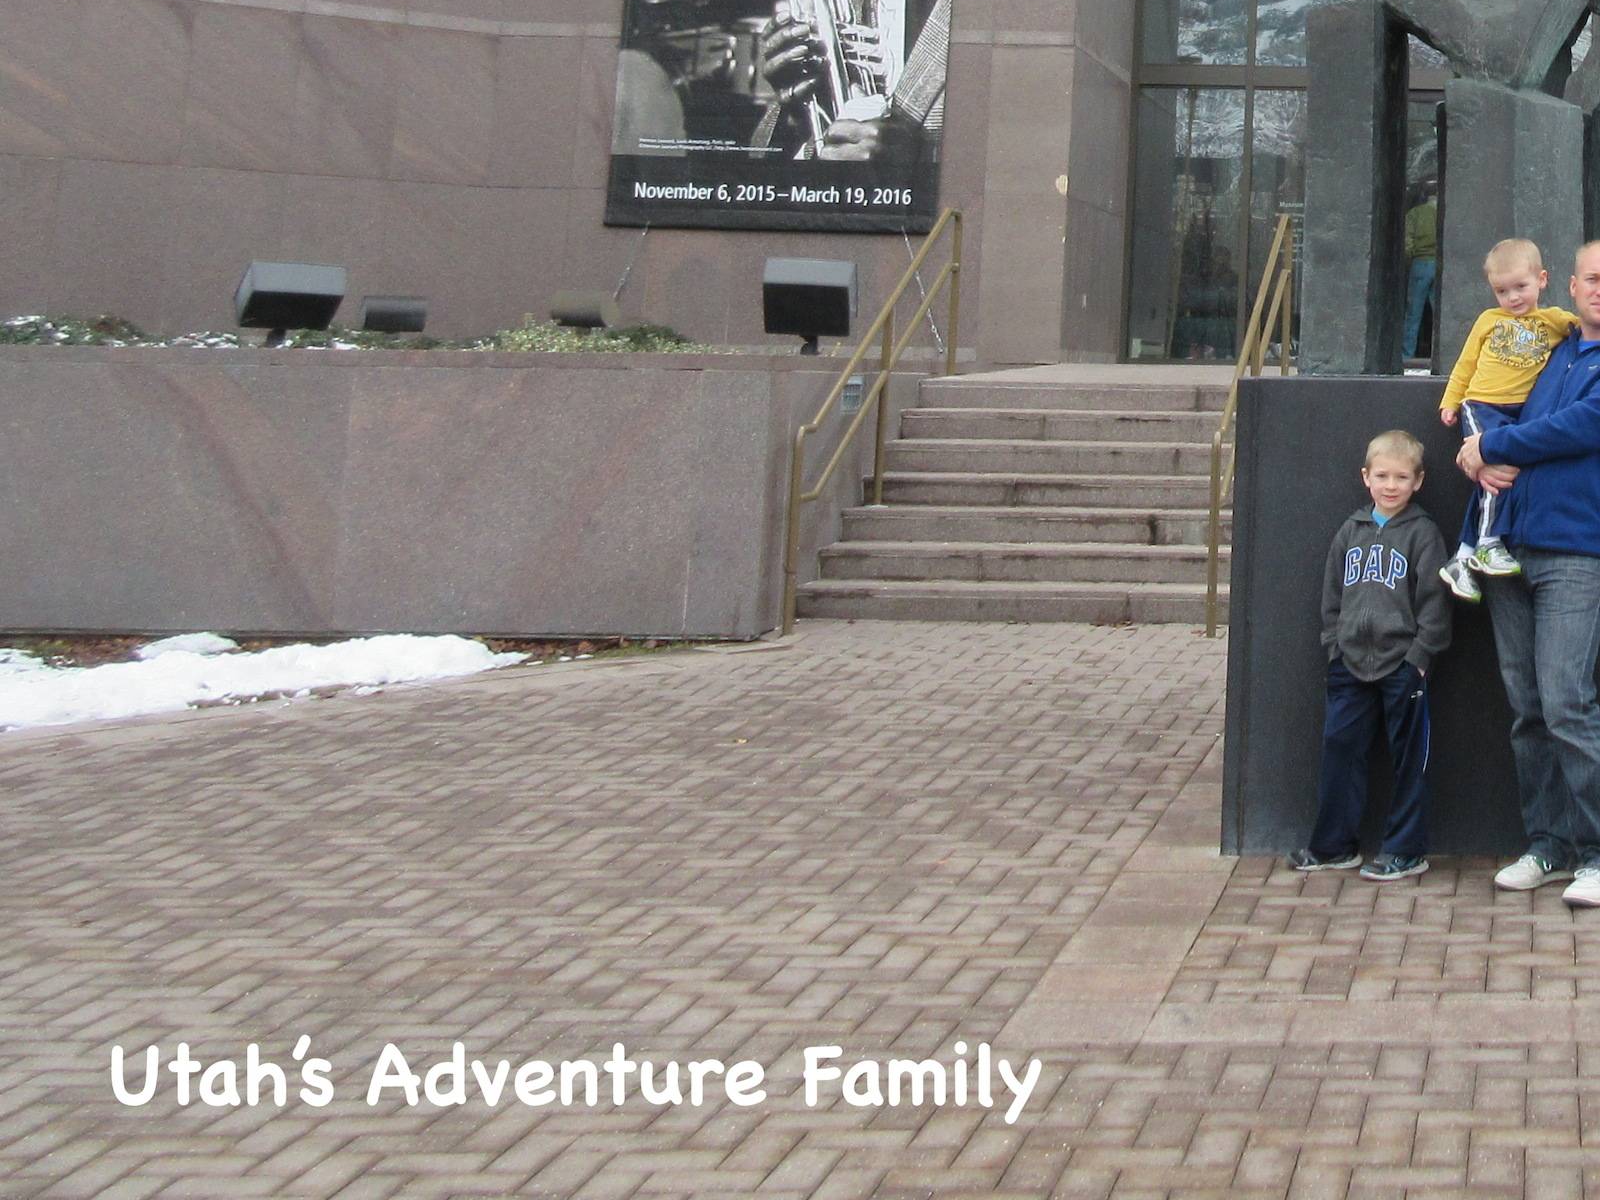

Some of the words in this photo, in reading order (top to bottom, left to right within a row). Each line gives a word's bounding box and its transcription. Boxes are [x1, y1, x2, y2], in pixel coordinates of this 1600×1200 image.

[634, 182, 714, 200] November
[717, 183, 732, 203] 6,
[845, 186, 869, 206] 19,
[872, 187, 913, 205] 2016
[1343, 543, 1408, 590] GAP
